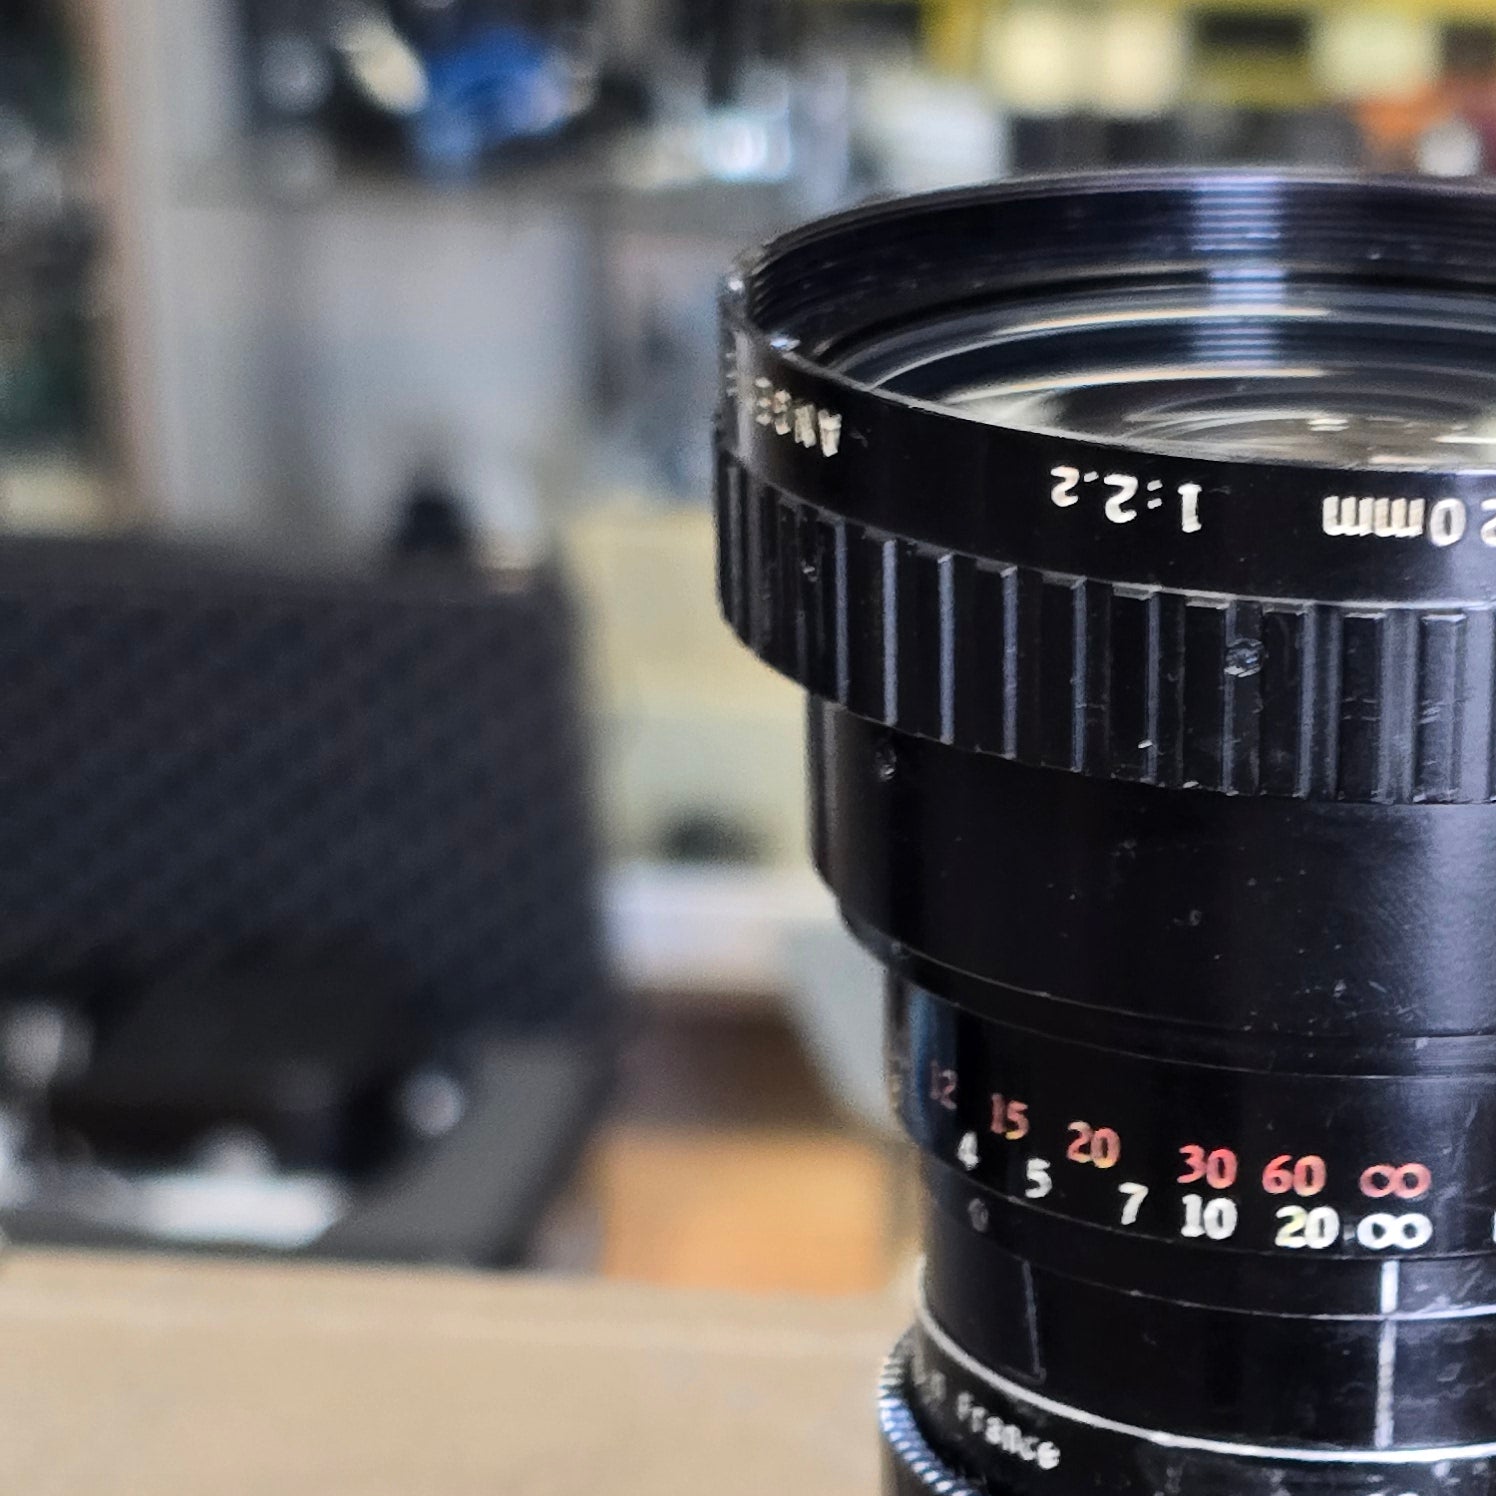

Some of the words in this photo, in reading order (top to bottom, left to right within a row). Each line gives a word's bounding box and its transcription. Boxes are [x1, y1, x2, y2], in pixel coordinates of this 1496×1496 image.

[1050, 464, 1201, 533] 1:2.2
[957, 1130, 981, 1170] 4
[1025, 1157, 1053, 1198] 5
[1117, 1181, 1149, 1225] 7
[1179, 1194, 1238, 1240] 10
[1275, 1205, 1339, 1250] 20
[990, 1092, 1029, 1140] 15
[1066, 1120, 1121, 1169] 20
[1178, 1144, 1238, 1189] 30
[1262, 1154, 1326, 1197] 60
